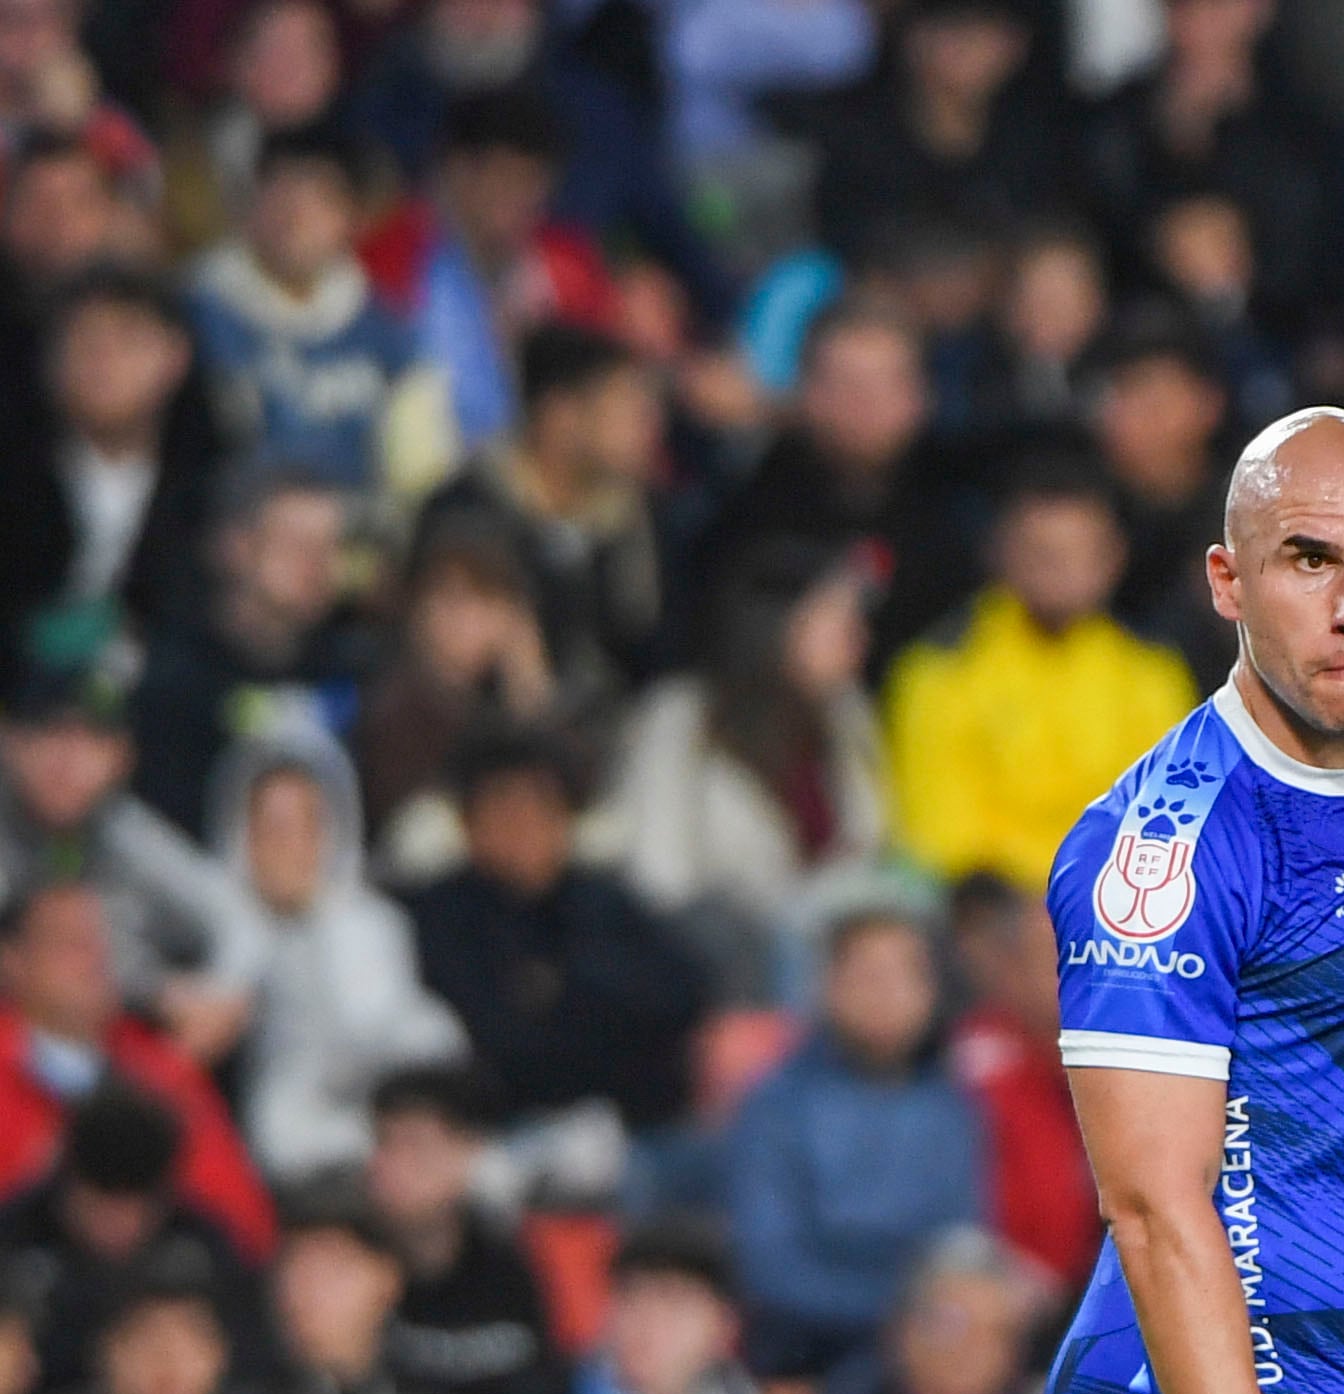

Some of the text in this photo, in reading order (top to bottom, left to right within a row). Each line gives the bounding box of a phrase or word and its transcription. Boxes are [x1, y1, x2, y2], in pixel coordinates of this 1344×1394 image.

[1067, 940, 1206, 980] LANDAJO
[1221, 1095, 1284, 1386] U.D. MARACENA
